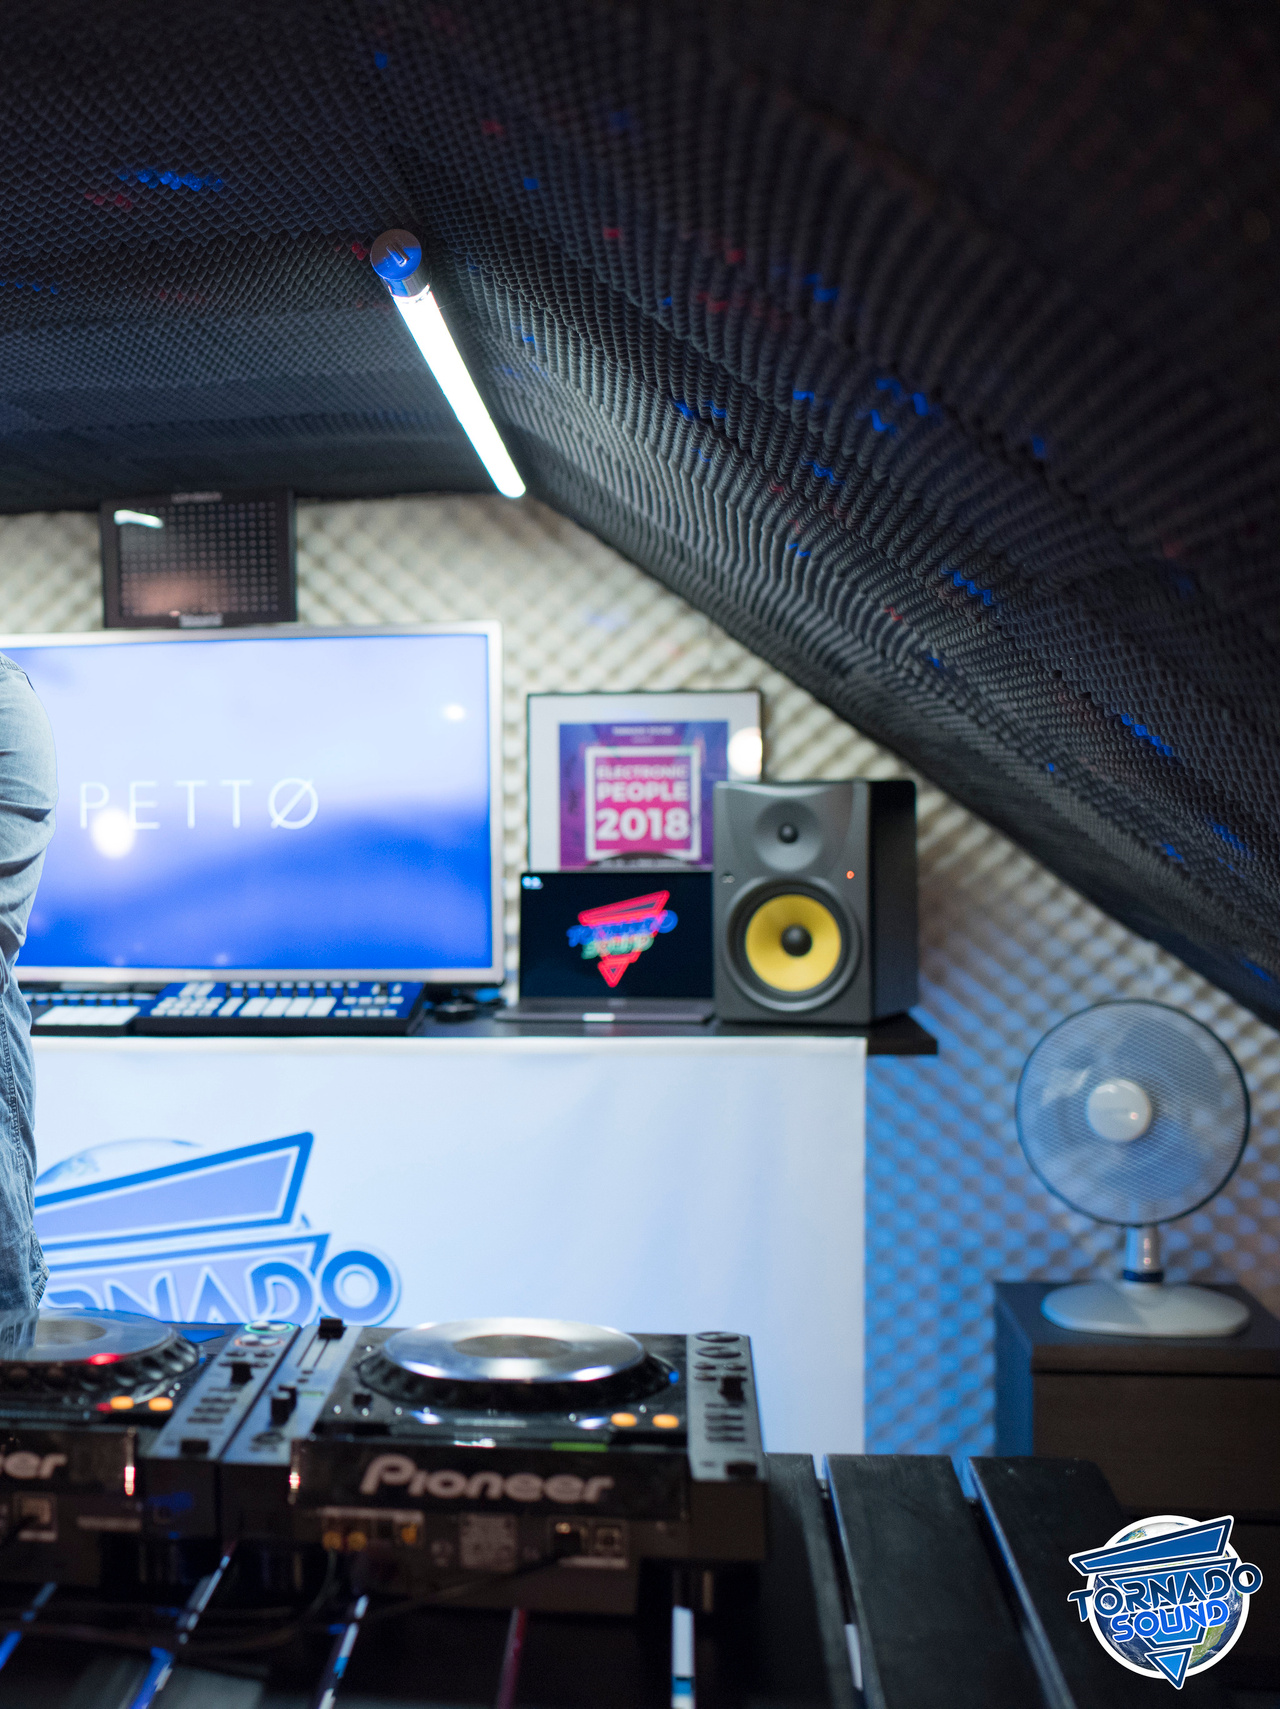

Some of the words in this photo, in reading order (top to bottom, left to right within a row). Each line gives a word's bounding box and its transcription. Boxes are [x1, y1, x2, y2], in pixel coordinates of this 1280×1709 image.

[596, 781, 690, 803] PEOPLE
[595, 807, 691, 842] 2018
[359, 1453, 615, 1504] Pioneer
